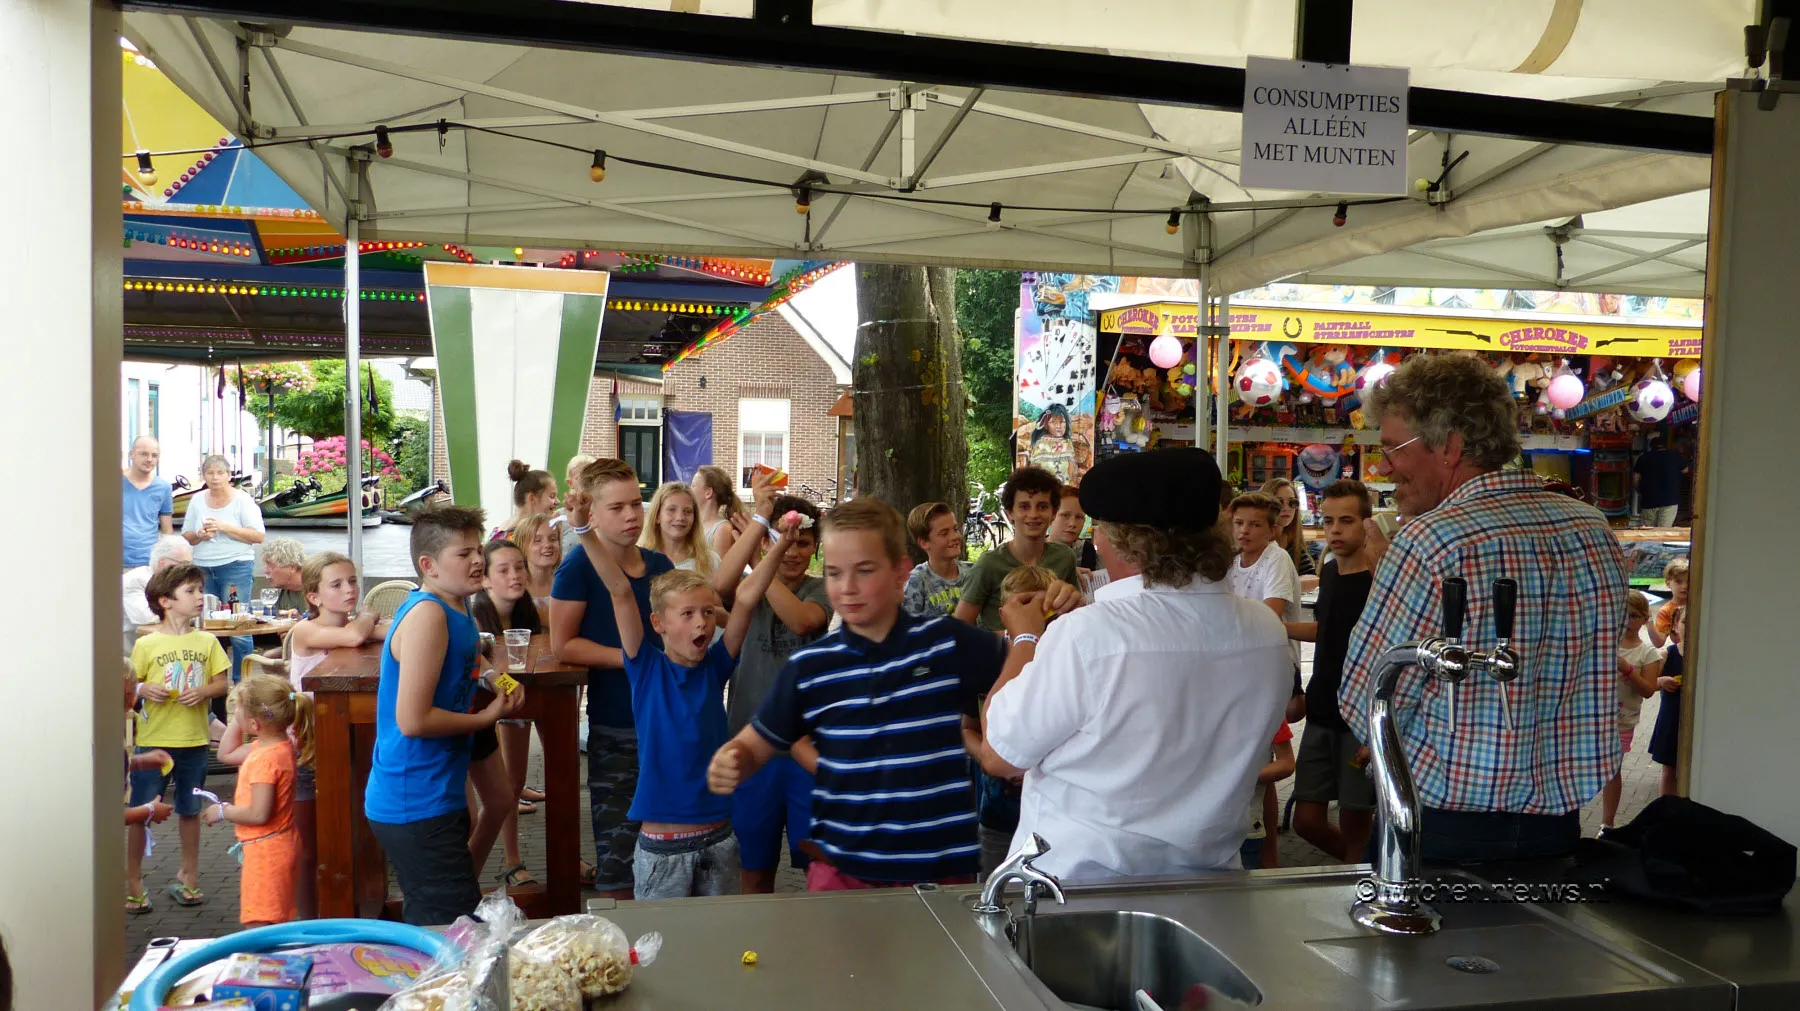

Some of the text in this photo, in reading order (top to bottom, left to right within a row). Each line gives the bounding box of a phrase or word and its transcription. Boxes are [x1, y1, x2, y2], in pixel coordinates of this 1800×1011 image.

[1253, 86, 1400, 114] CONSUMPTIES
[1283, 114, 1367, 139] ALLÉÉN
[1253, 142, 1396, 167] MET MUNTEN
[1117, 308, 1160, 330] CHEROKEE
[1313, 321, 1372, 331] PAINTBALL
[1500, 327, 1589, 350] CHEROKEE
[156, 649, 208, 667] COOL BEACH
